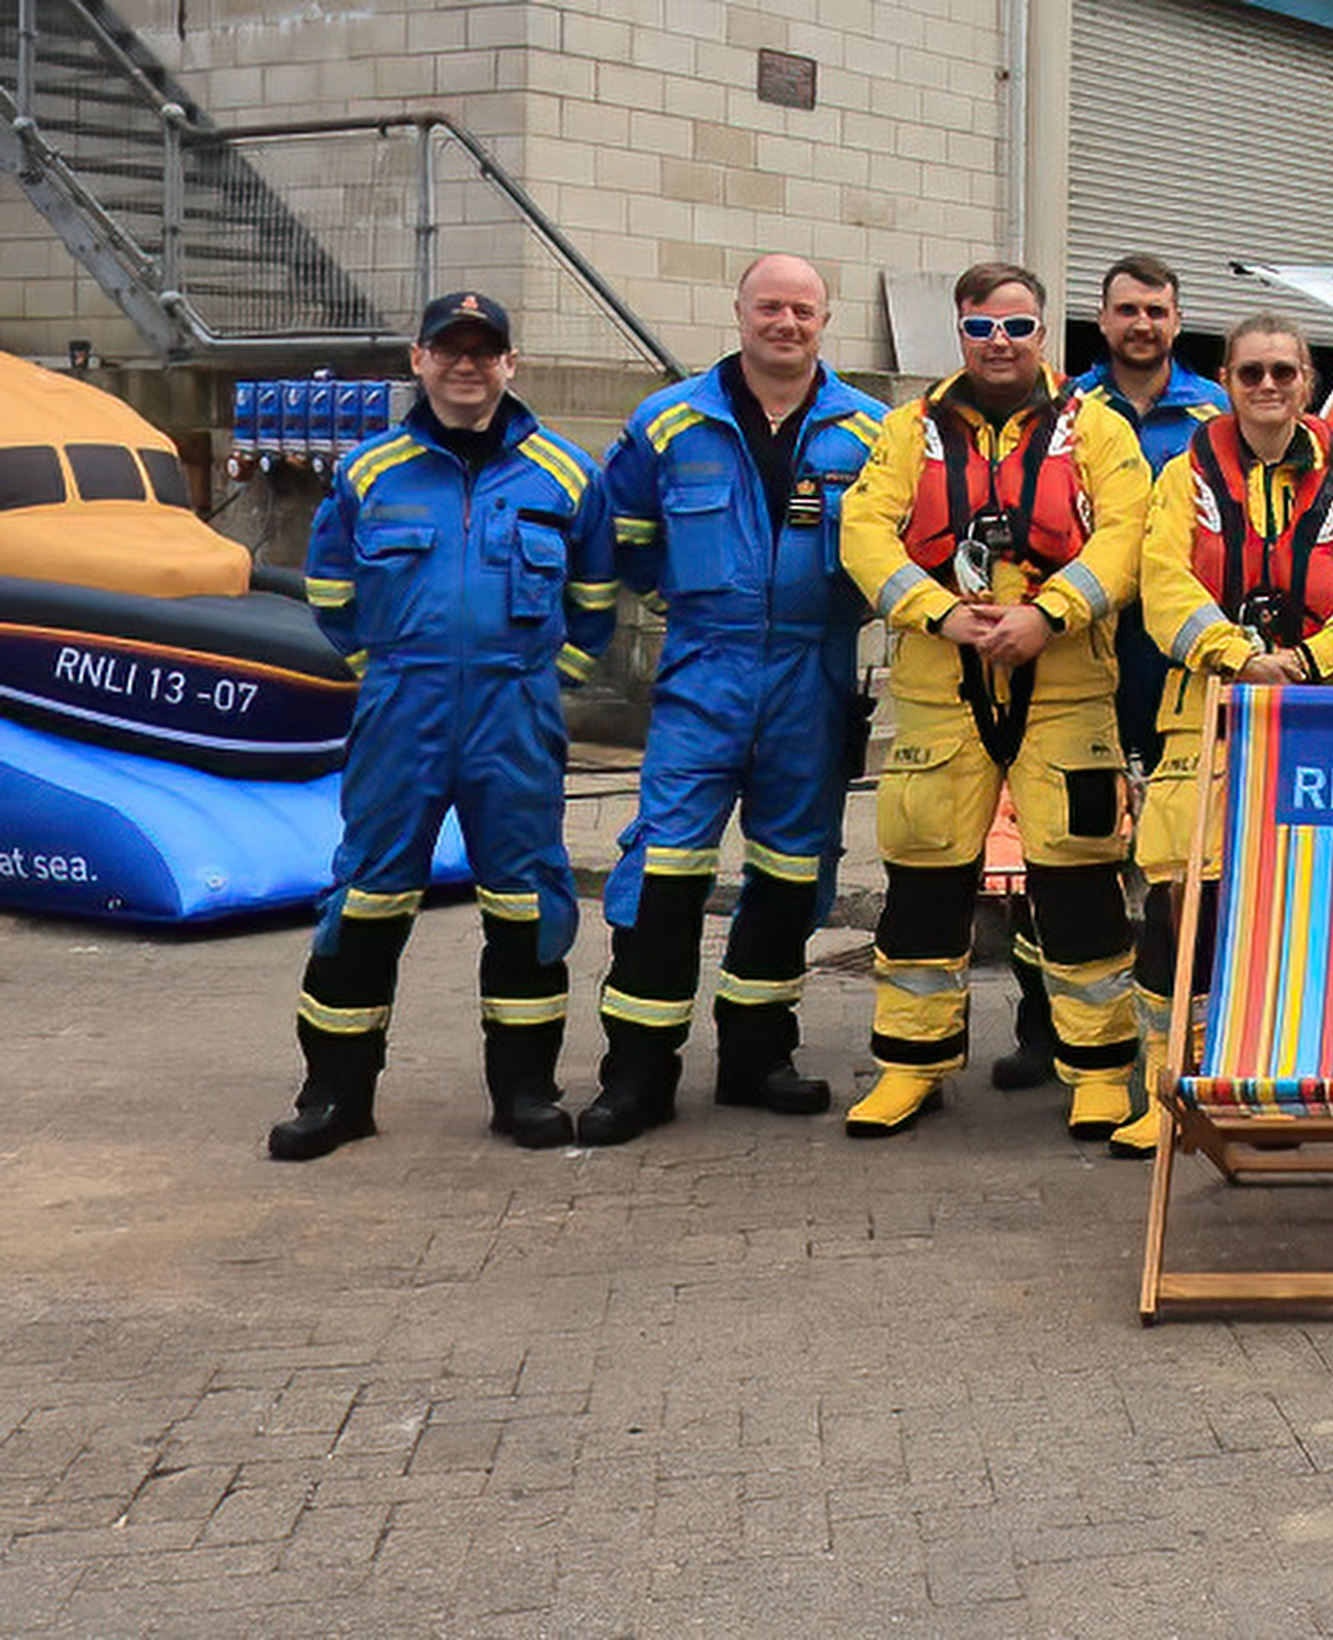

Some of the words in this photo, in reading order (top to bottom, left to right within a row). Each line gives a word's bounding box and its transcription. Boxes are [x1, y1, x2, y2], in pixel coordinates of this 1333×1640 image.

[54, 646, 138, 695] RNLI
[150, 668, 186, 704] 13
[33, 854, 98, 881] sea.
